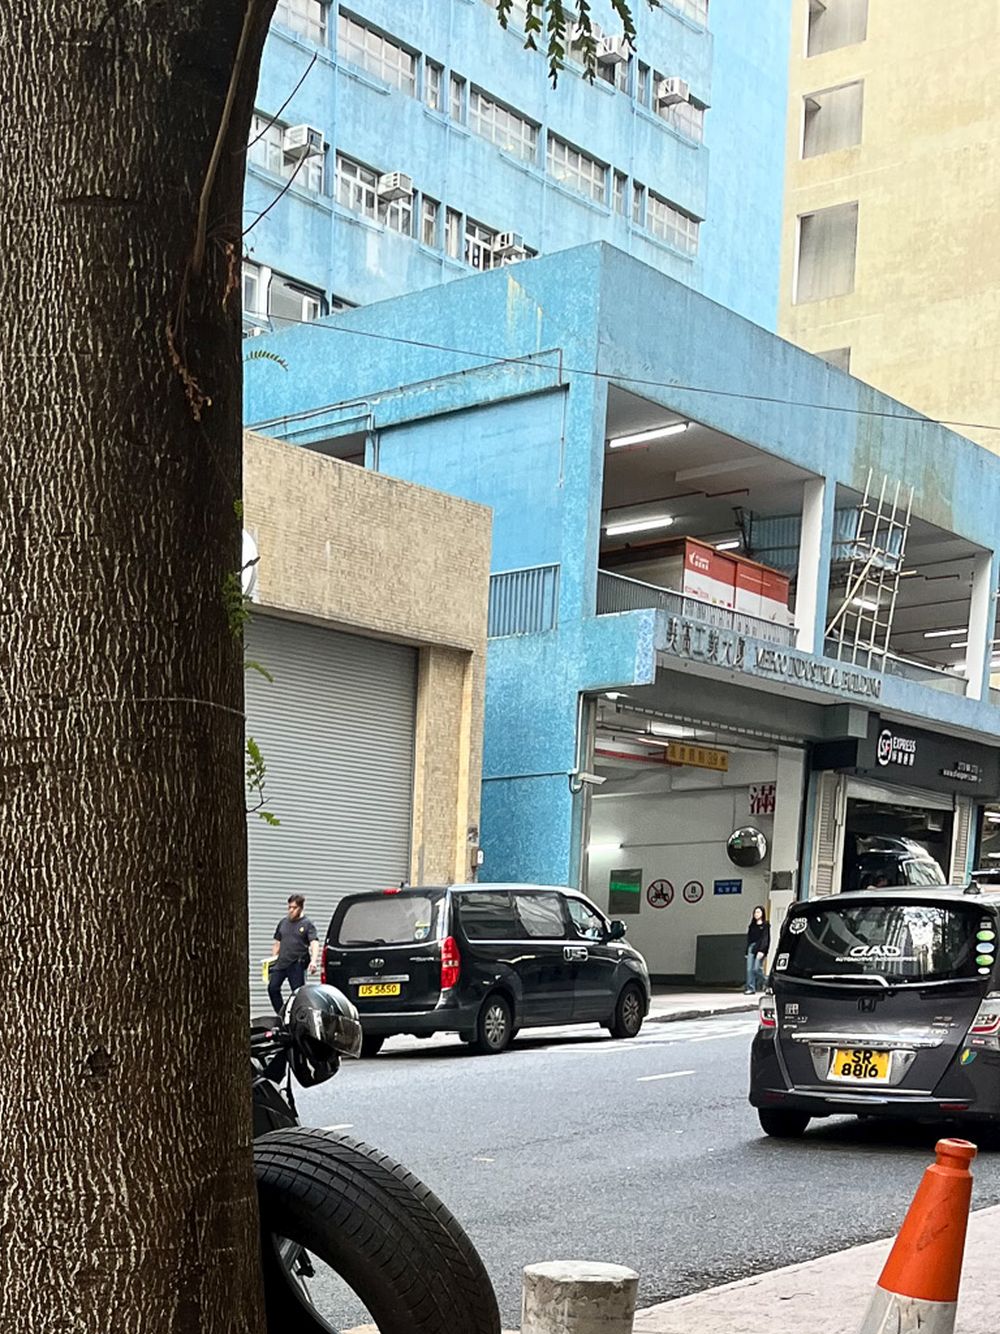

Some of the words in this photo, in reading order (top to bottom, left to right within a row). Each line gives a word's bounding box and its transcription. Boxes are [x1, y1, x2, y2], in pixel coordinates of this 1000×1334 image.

[893, 737, 917, 752] EXPRESS
[361, 987, 373, 995] US
[851, 1051, 873, 1065] SR
[841, 1063, 879, 1079] 8816
